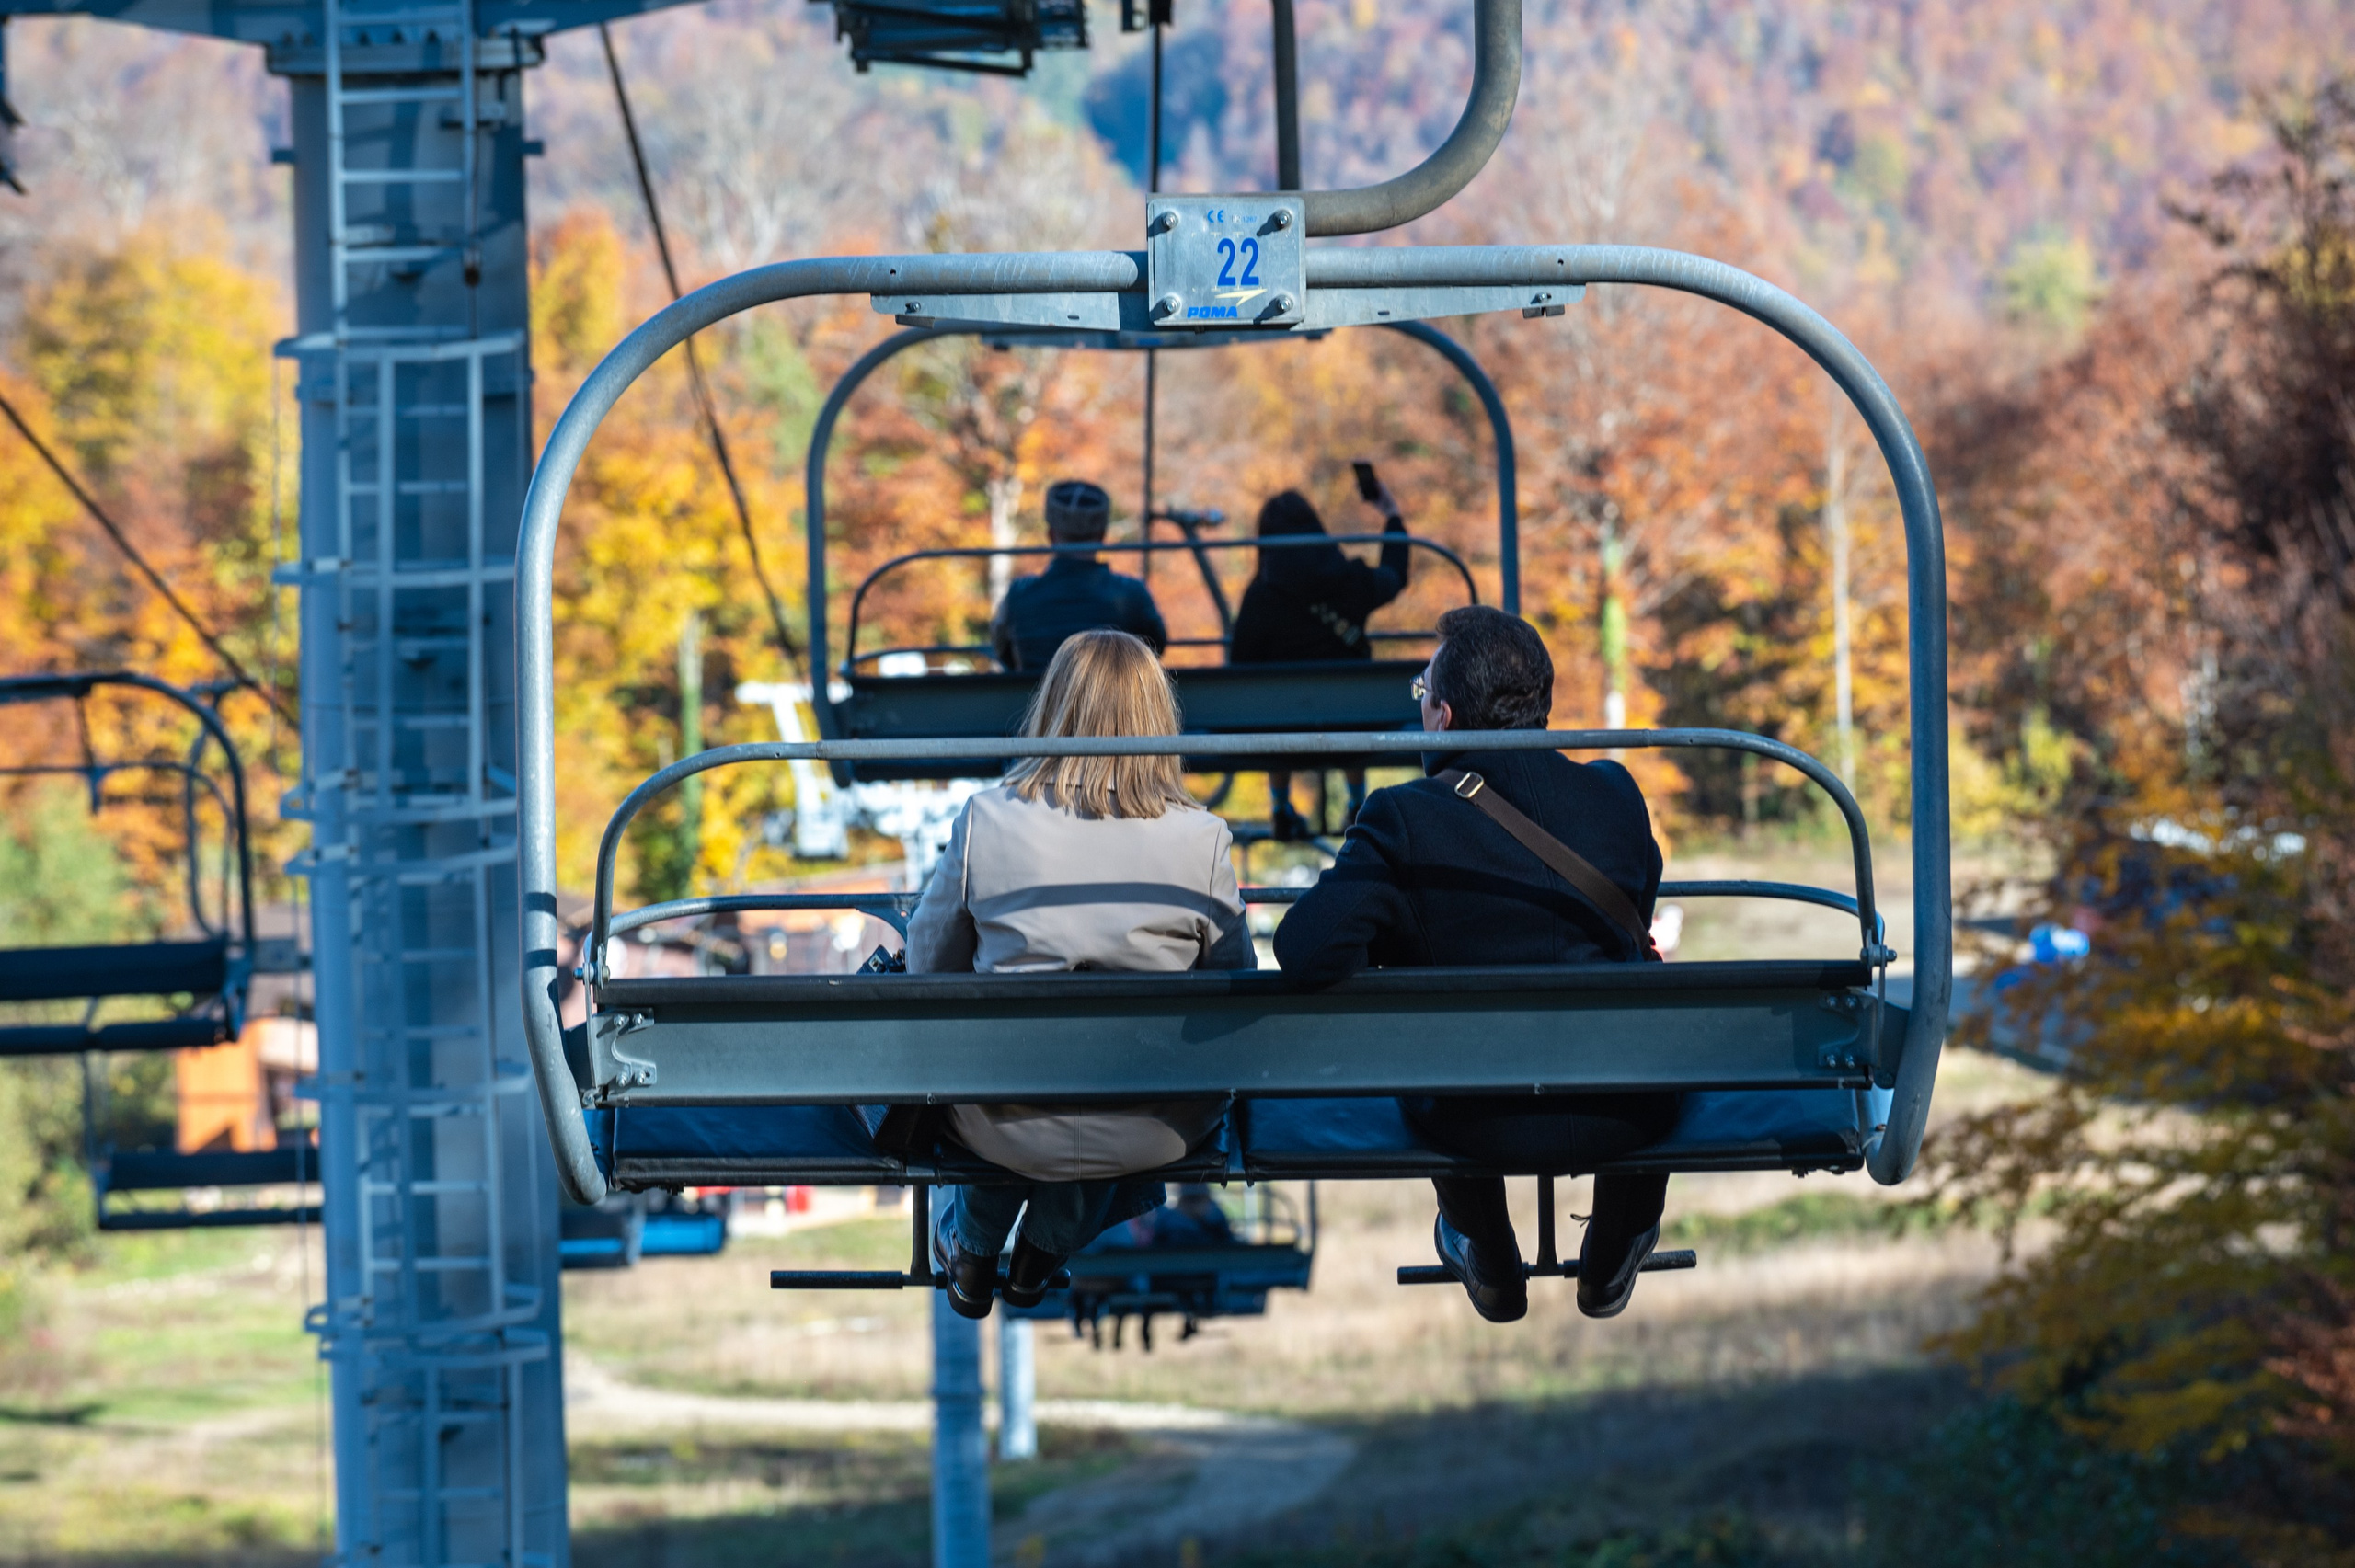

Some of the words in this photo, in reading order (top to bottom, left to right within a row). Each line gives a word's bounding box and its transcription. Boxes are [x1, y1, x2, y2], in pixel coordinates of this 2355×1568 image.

[1207, 209, 1224, 223] CE
[1217, 237, 1259, 286] 22
[1187, 306, 1238, 318] POMA
